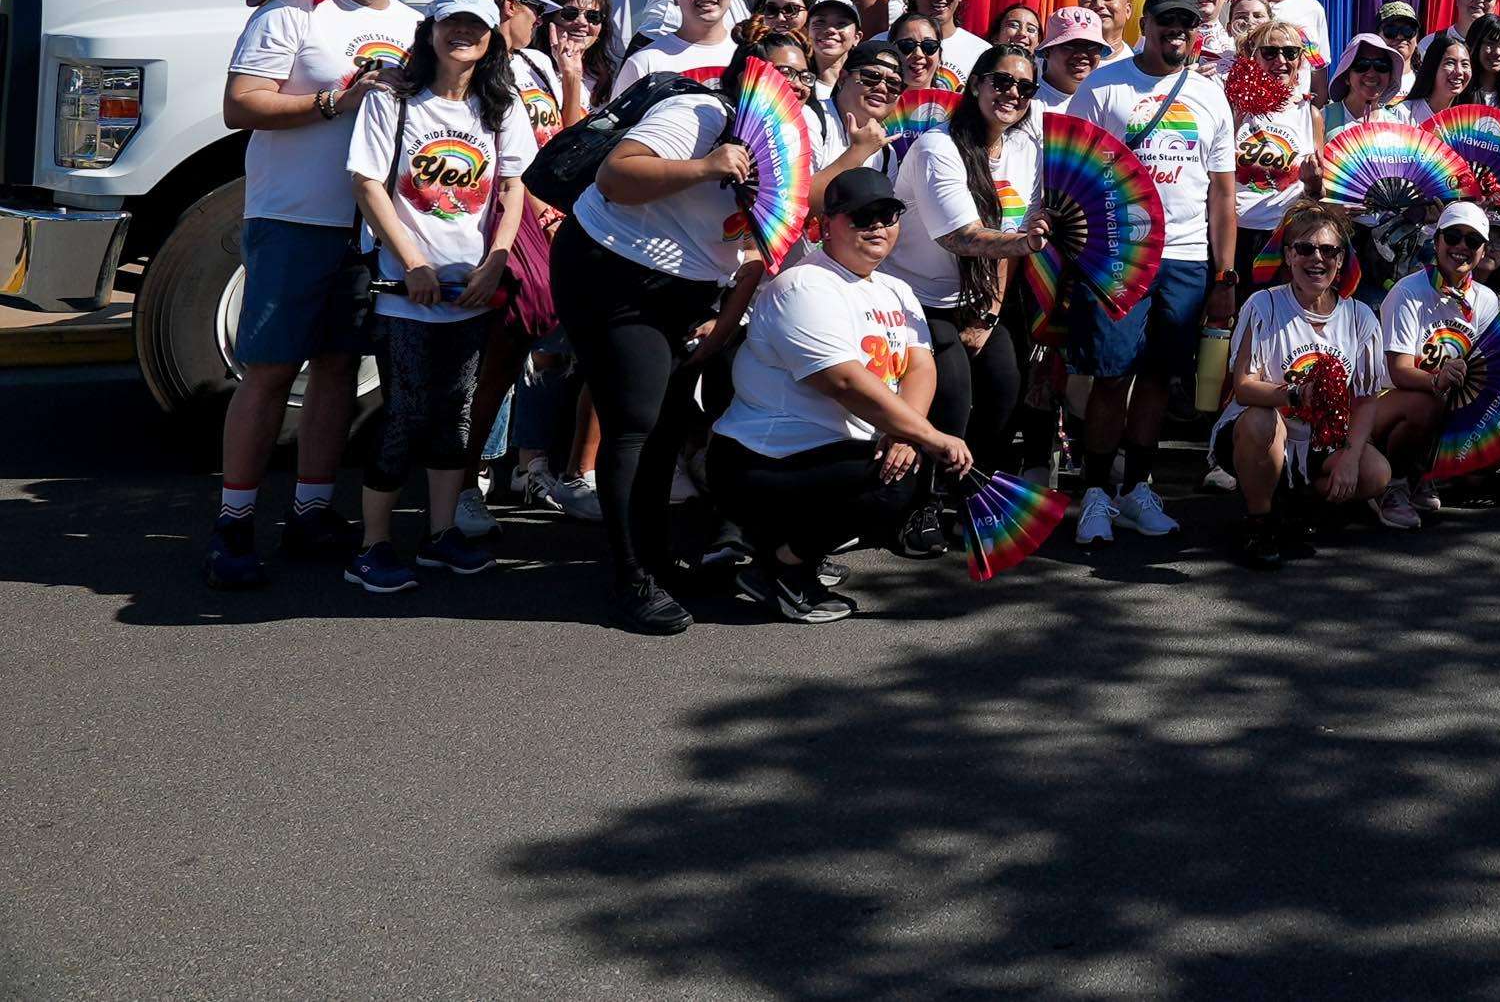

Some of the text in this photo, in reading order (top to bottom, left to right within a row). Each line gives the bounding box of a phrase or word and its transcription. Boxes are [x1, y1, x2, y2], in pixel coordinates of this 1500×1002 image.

[407, 139, 423, 156] OUR
[423, 130, 445, 141] RIDE
[446, 130, 478, 145] STARTS
[763, 115, 785, 187] Hawaiian
[1158, 152, 1184, 162] Starts
[1237, 141, 1299, 172] Yes!
[412, 155, 490, 189] Yes!
[1365, 152, 1416, 165] Hawaiian
[1105, 190, 1119, 256] Hawaiian
[1444, 319, 1469, 332] STARTS
[1281, 354, 1294, 371] OUR
[1292, 343, 1314, 357] PRIDE
[1314, 343, 1342, 358] STARTS
